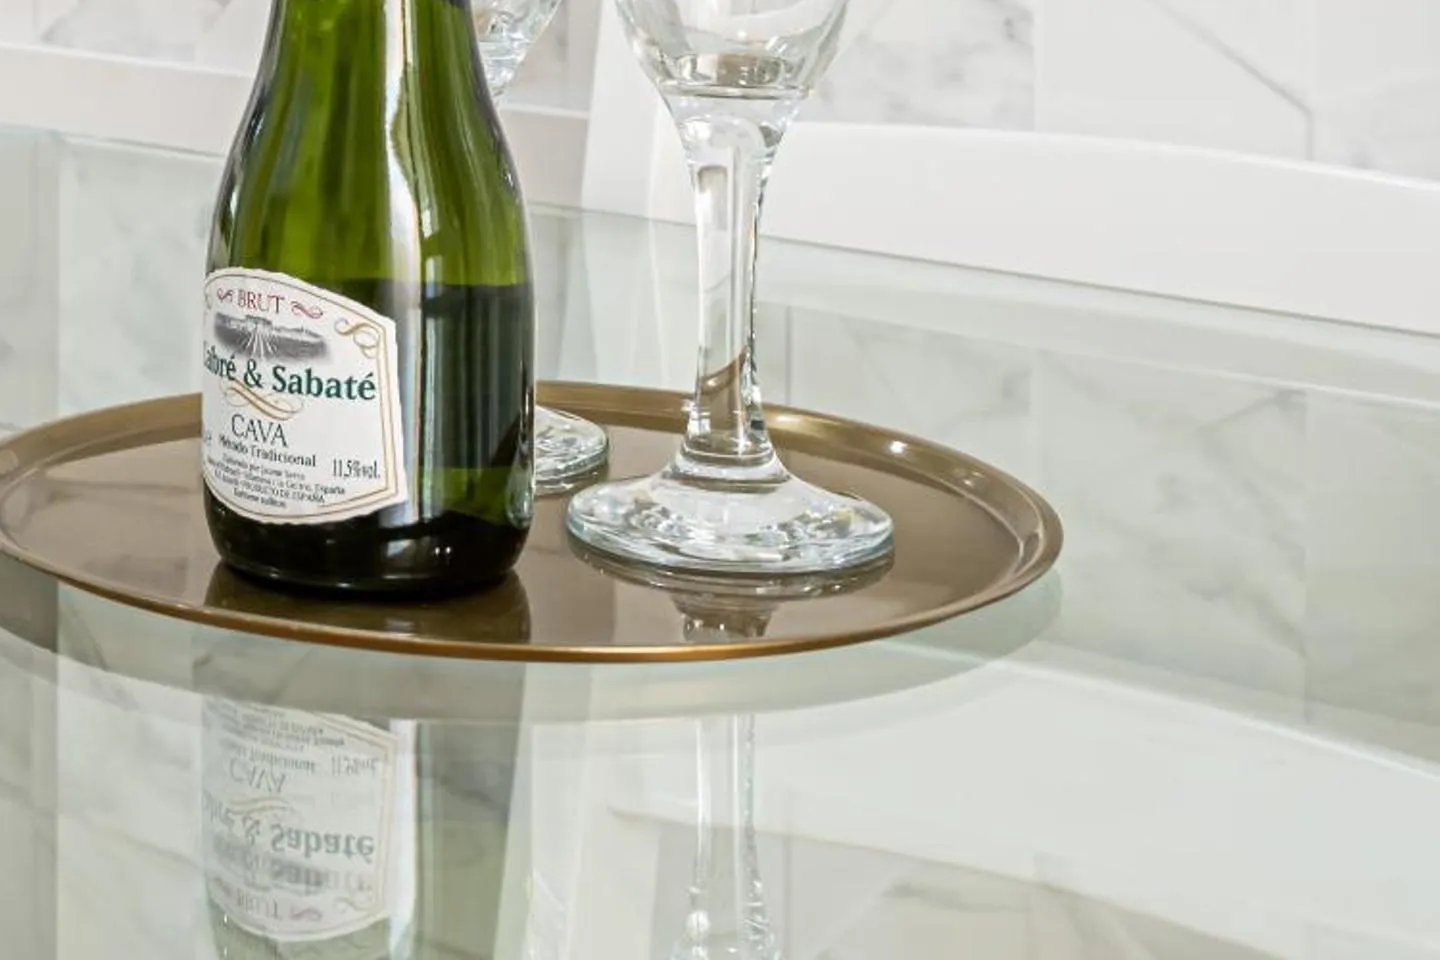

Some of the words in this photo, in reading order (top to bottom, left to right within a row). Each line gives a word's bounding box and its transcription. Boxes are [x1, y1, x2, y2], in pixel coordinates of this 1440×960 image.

[237, 290, 285, 315] BRUT
[203, 344, 237, 381] abré
[243, 358, 263, 389] &
[271, 364, 377, 401] Sabaté
[231, 413, 289, 448] CAVA
[250, 445, 317, 468] Tradicional
